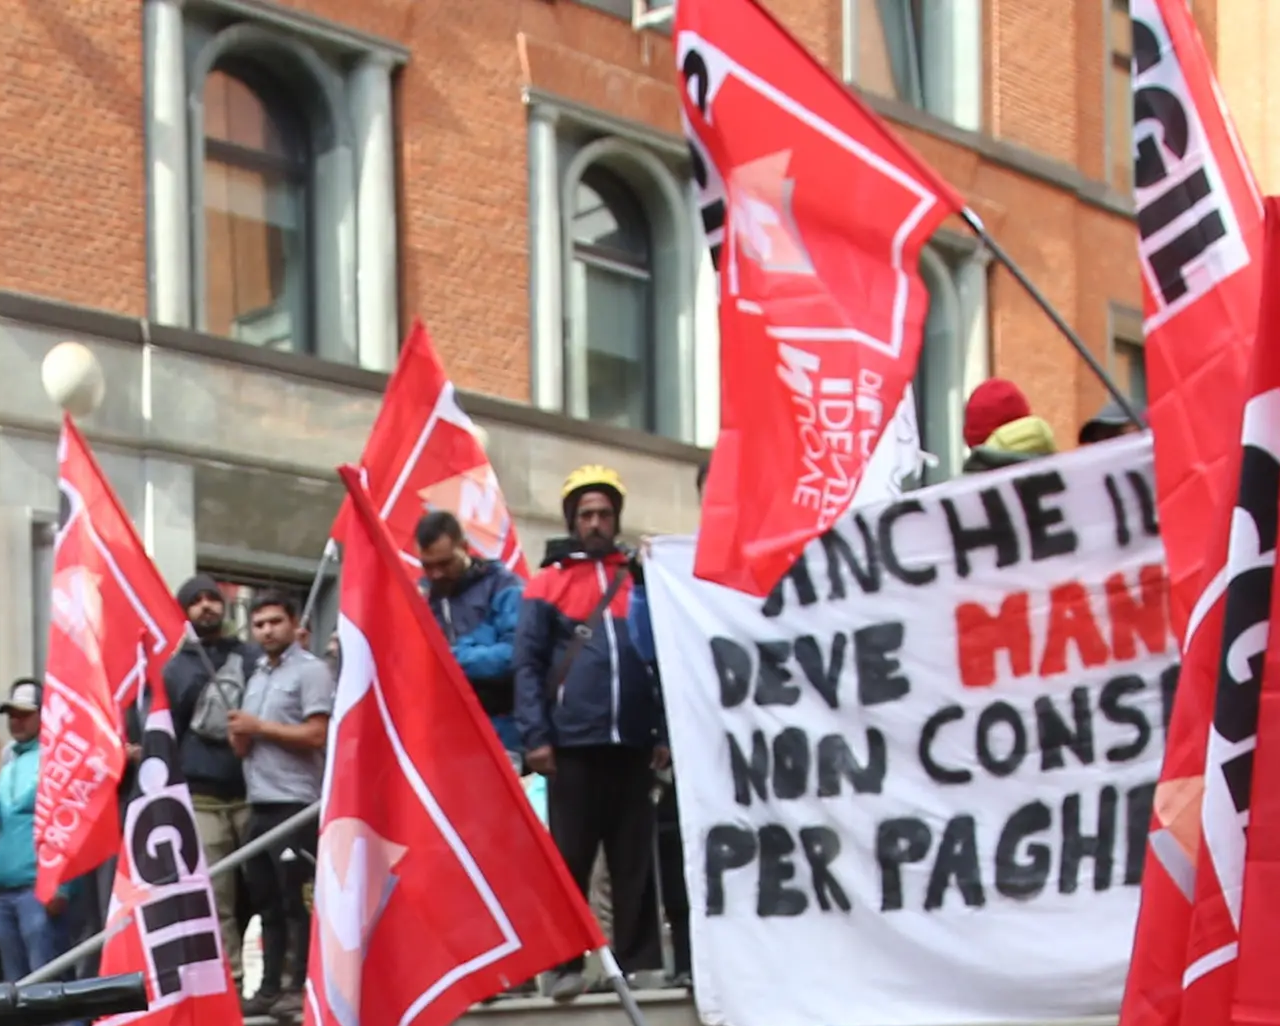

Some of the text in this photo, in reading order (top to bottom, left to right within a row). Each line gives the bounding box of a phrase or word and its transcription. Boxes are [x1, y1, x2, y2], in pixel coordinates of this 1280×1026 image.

[710, 621, 911, 709] DEVE
[726, 726, 888, 806] NON
[704, 822, 852, 917] PER
